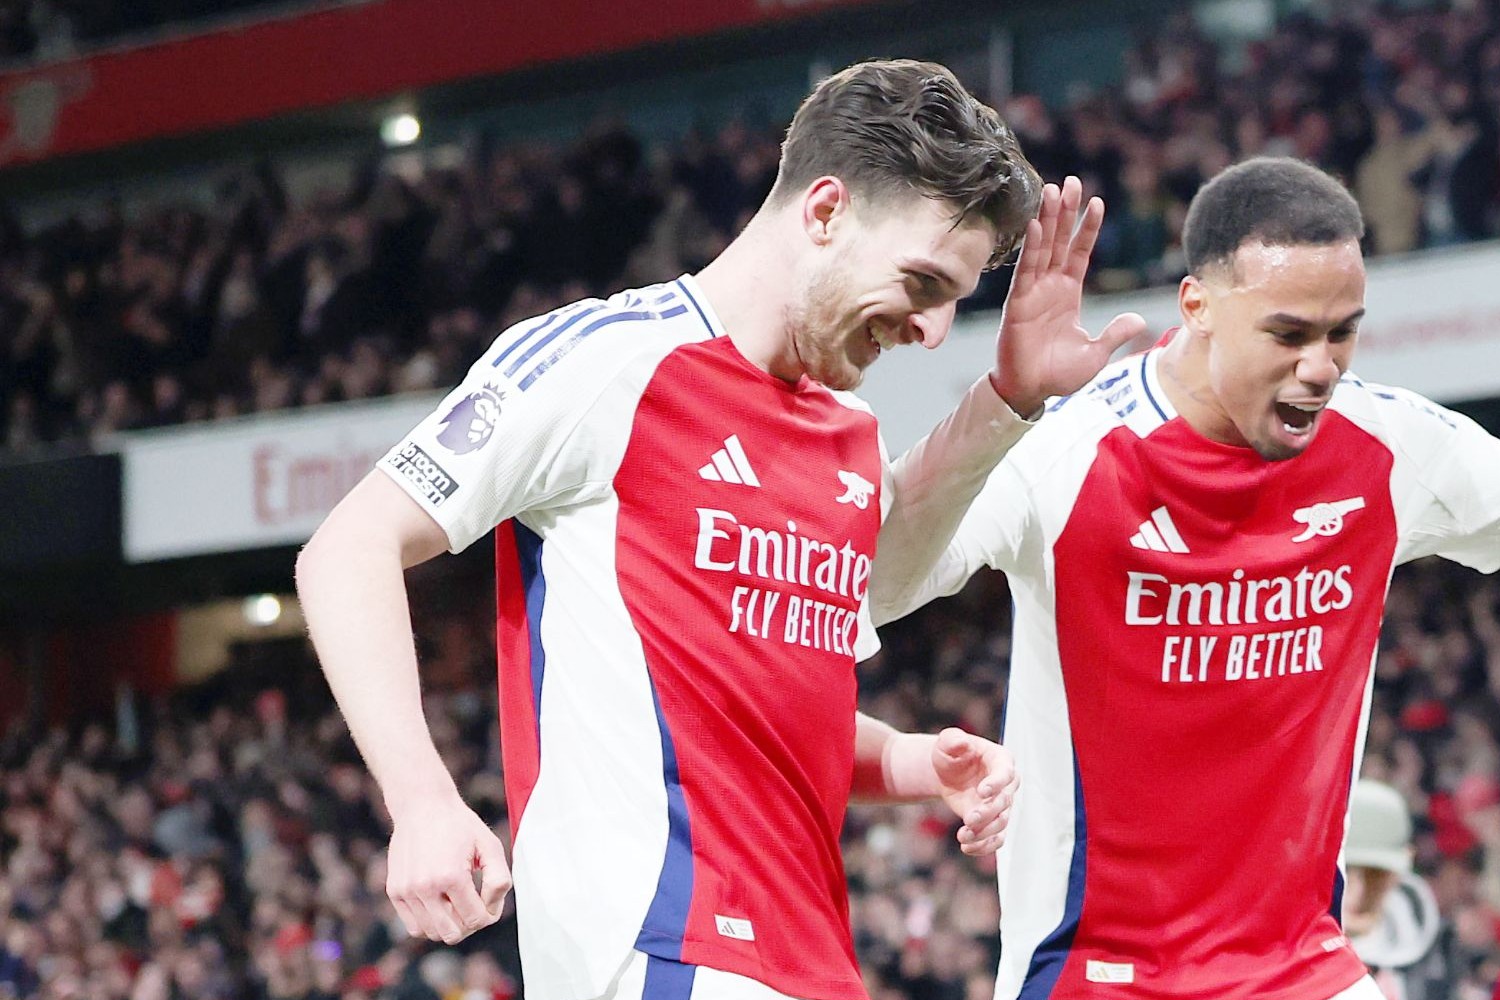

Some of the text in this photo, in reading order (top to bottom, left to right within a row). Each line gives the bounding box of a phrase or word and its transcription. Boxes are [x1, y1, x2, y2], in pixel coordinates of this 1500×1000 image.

[695, 507, 872, 602] Emirate
[729, 585, 857, 658] FLY BETTER
[1124, 564, 1354, 627] Emirates
[1160, 625, 1325, 684] FLY BETTER
